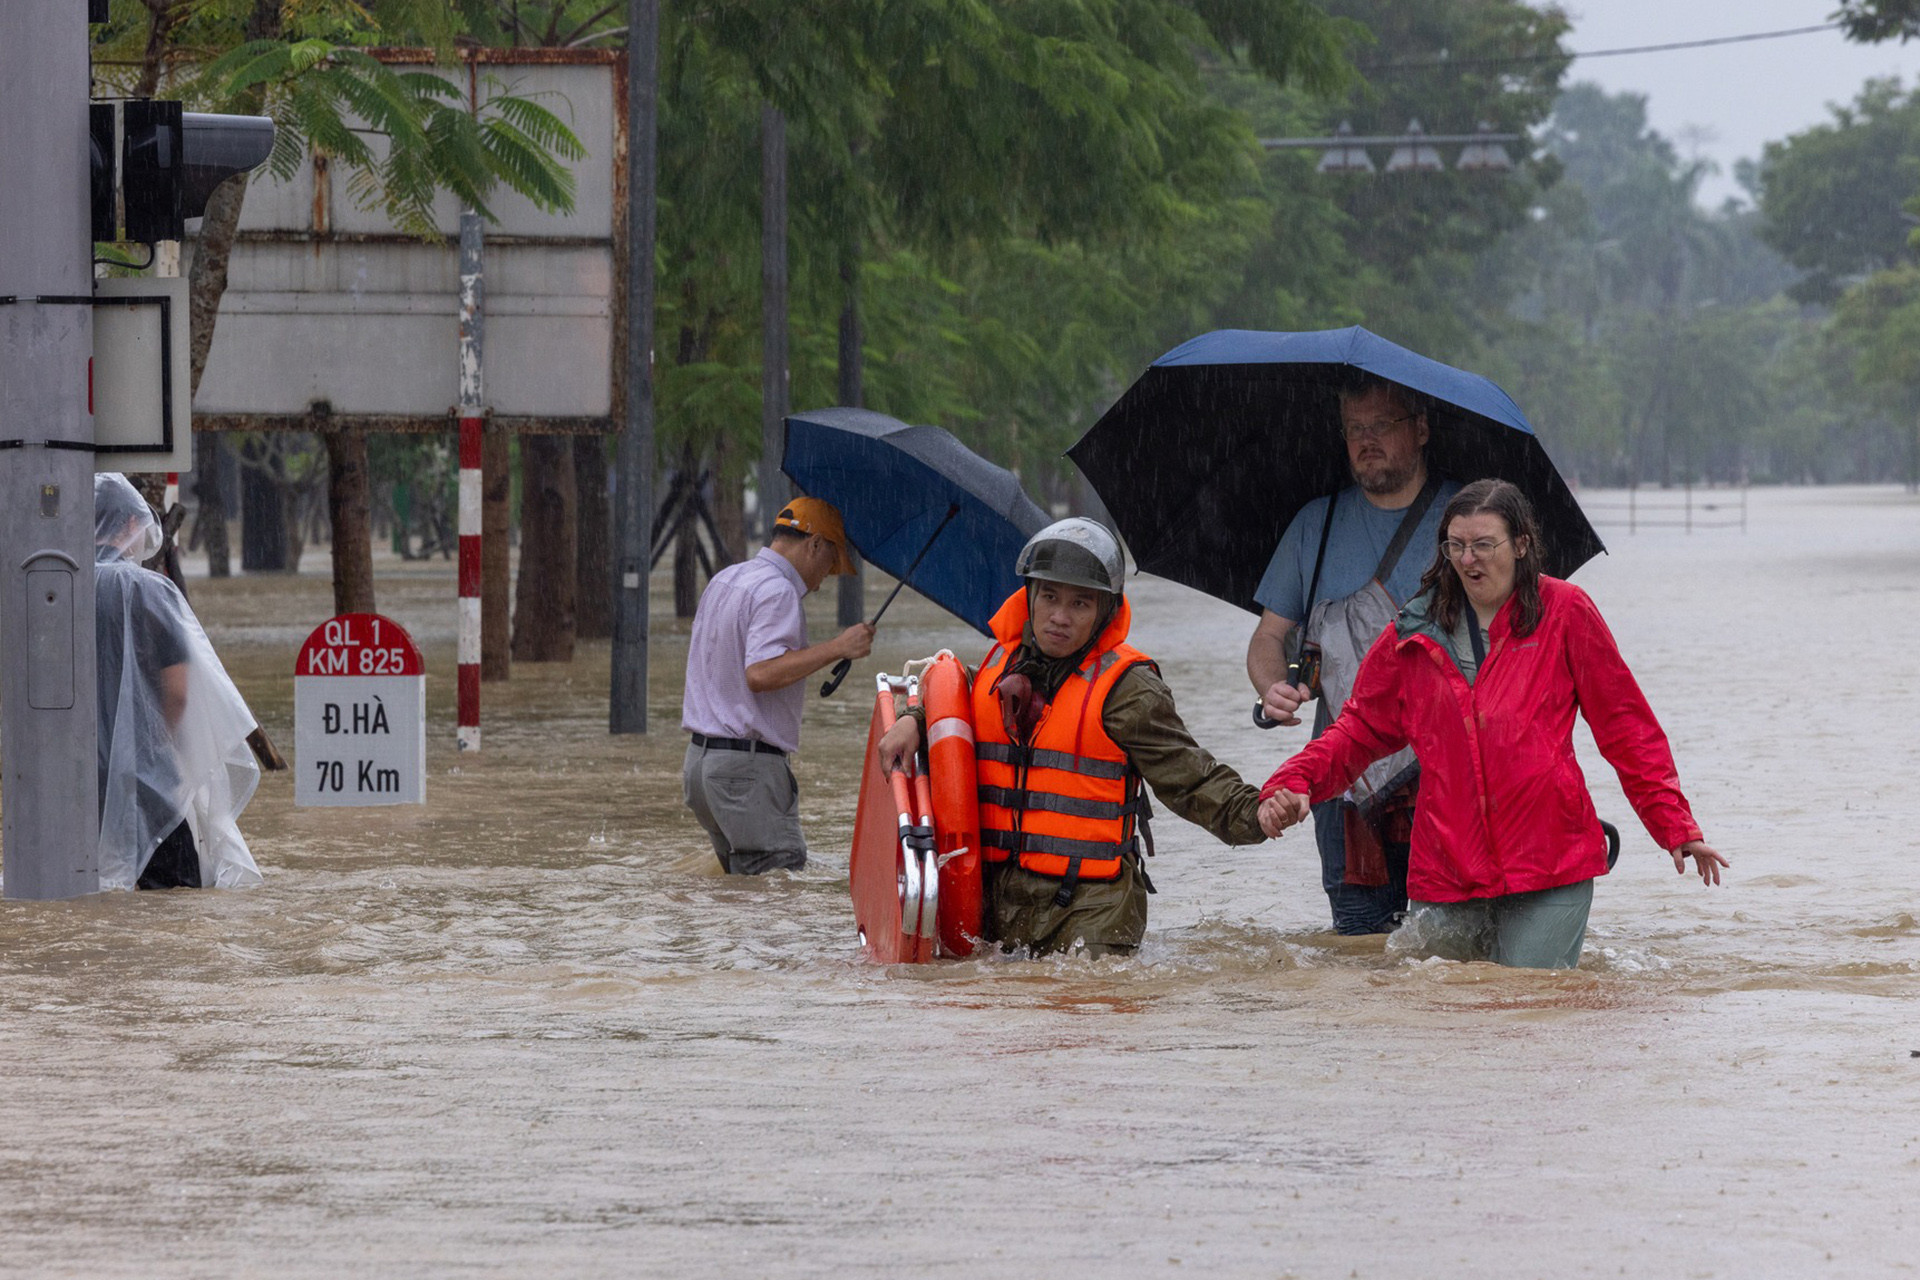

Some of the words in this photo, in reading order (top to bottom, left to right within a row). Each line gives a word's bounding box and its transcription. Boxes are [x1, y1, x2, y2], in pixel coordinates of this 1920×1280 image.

[324, 619, 360, 646] QL
[371, 619, 380, 646] 1
[308, 647, 349, 674] KM
[359, 647, 404, 674] 825
[322, 694, 390, 735] Đ.HÀ
[316, 761, 344, 792] 70
[358, 760, 400, 792] Km
